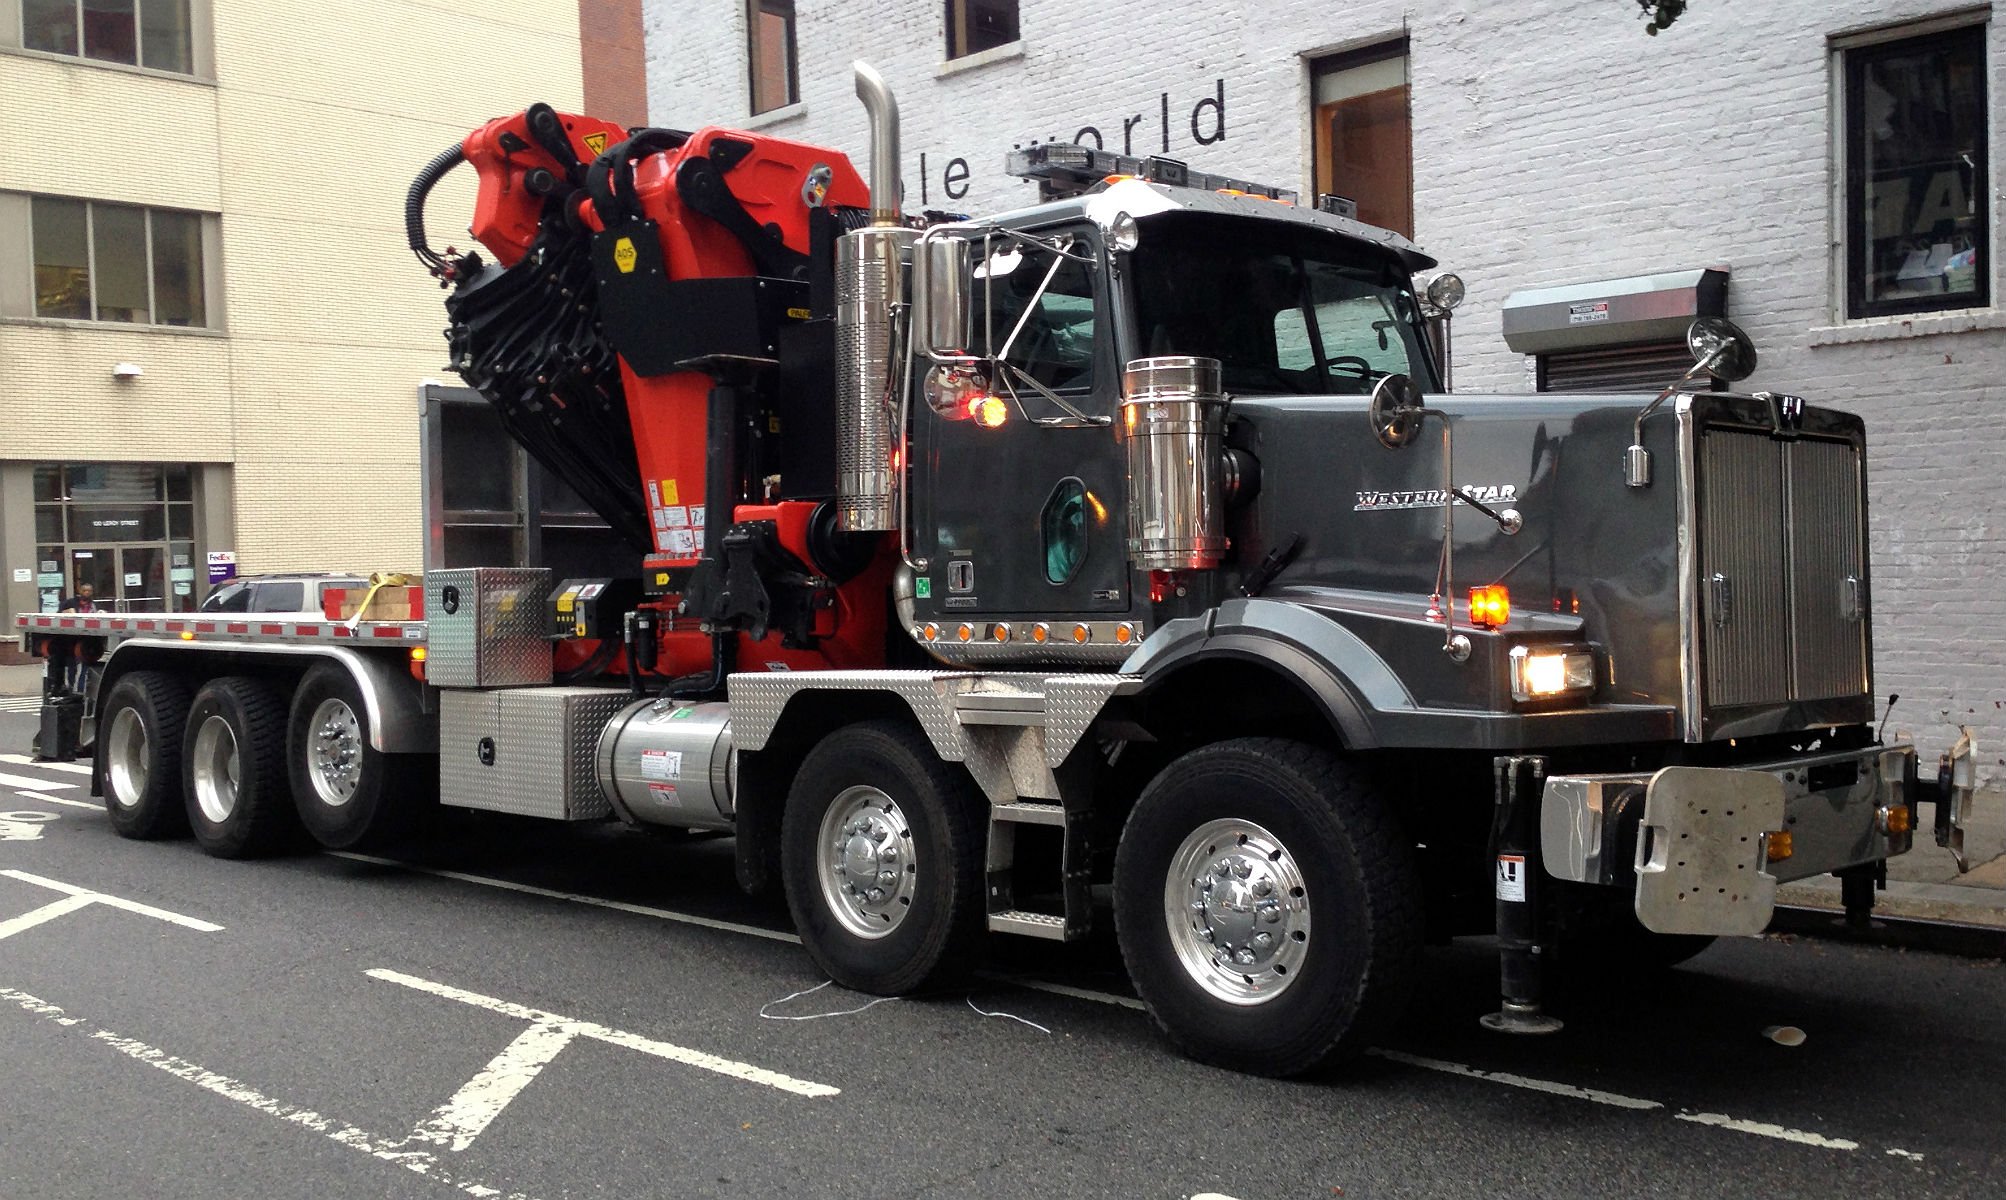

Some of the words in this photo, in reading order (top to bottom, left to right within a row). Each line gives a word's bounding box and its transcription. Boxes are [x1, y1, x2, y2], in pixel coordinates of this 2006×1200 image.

[899, 151, 970, 206] le
[1461, 484, 1518, 501] STAR
[209, 553, 231, 561] FedEx
